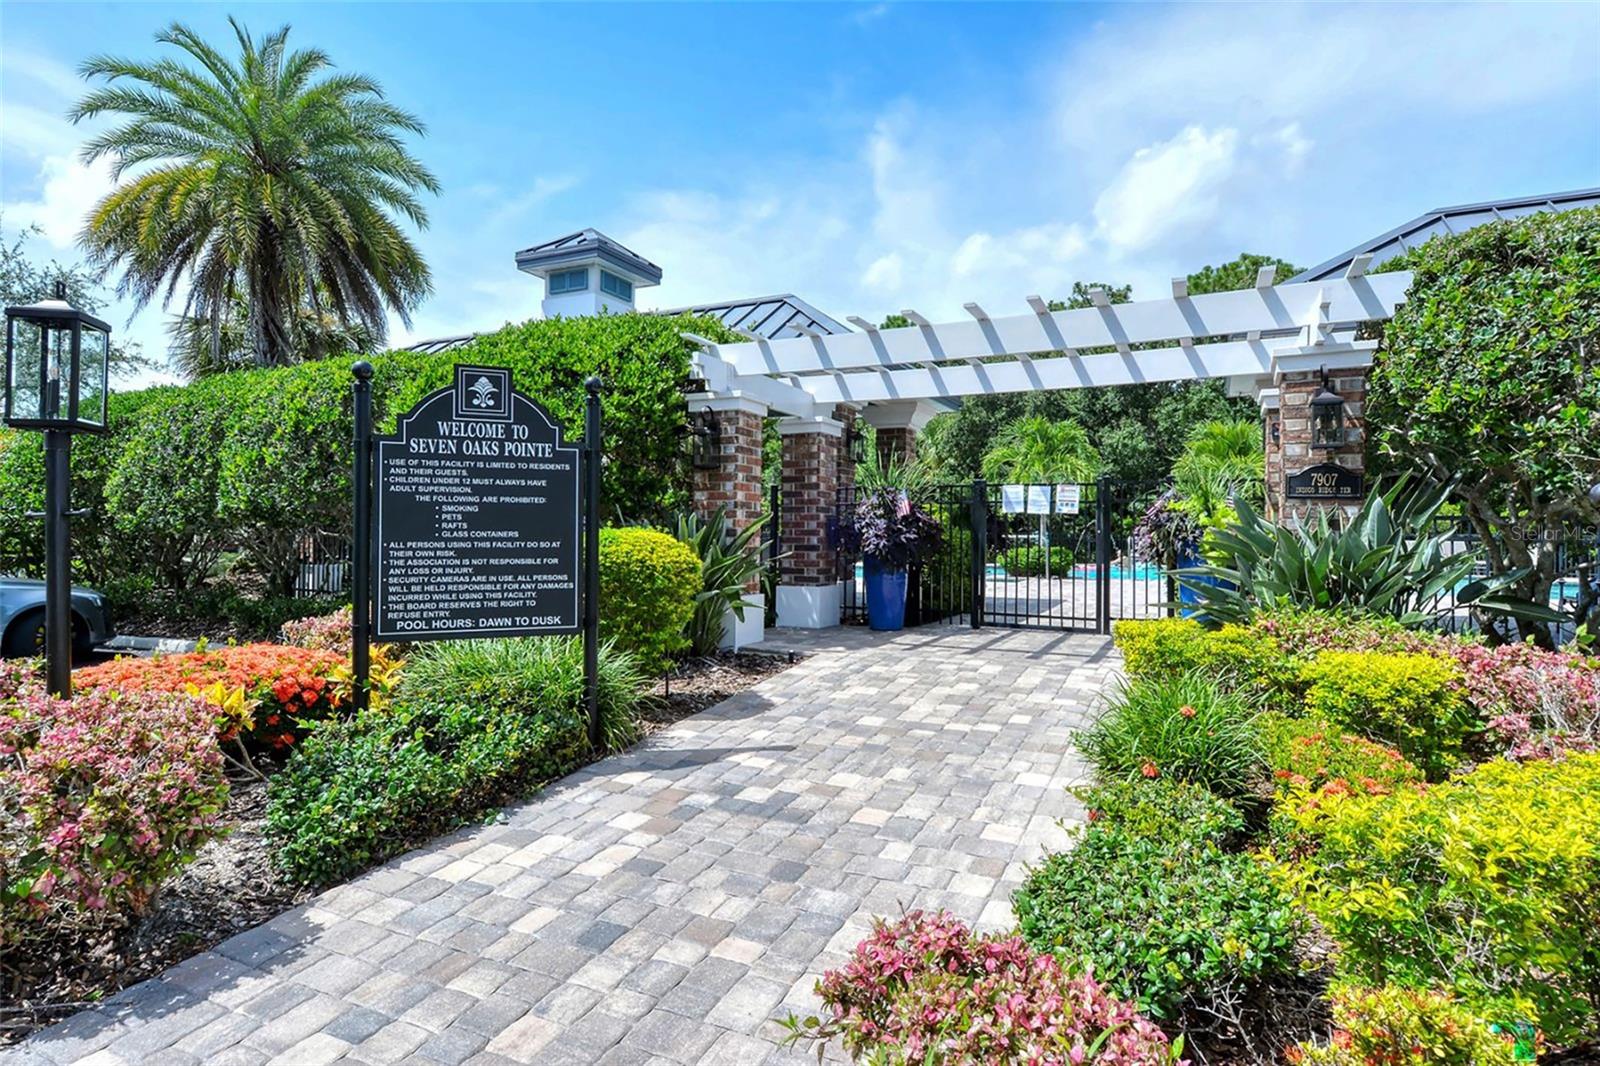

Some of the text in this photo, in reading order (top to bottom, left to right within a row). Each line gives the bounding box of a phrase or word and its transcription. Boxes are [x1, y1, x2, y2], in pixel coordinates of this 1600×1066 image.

[437, 421, 528, 439] WELCOME TO
[409, 438, 553, 458] SEVEN OAKS POINTE
[441, 460, 475, 468] FACILITY
[486, 462, 516, 470] LIMITED
[529, 462, 570, 471] RESIDENTS
[410, 468, 432, 476] THEIR
[434, 468, 468, 476] GUESTS.
[389, 476, 430, 484] CHILDREN
[1311, 473, 1338, 486] 7907
[418, 486, 472, 494] SUPERVISION.
[432, 495, 480, 503] FOLLOWING
[500, 496, 547, 504] PROHIBITED:
[442, 504, 478, 512] SMOKING
[442, 513, 462, 521] PETS
[442, 522, 468, 530] RAFTS
[442, 530, 519, 538] GLASS CONTAINERS
[412, 584, 422, 592] BE
[424, 584, 446, 592] HELD
[448, 583, 501, 592] RESPONSIBLE
[388, 594, 430, 602] INCURRED
[459, 592, 483, 600] USING
[388, 603, 405, 611] THE
[407, 602, 436, 610] BOARD
[438, 600, 481, 609] RESERVES
[500, 600, 524, 608] RIGHT
[388, 610, 450, 620] REFUSE ENTRY.
[396, 616, 562, 630] POOL HOURS: DAWN TO DUSK
